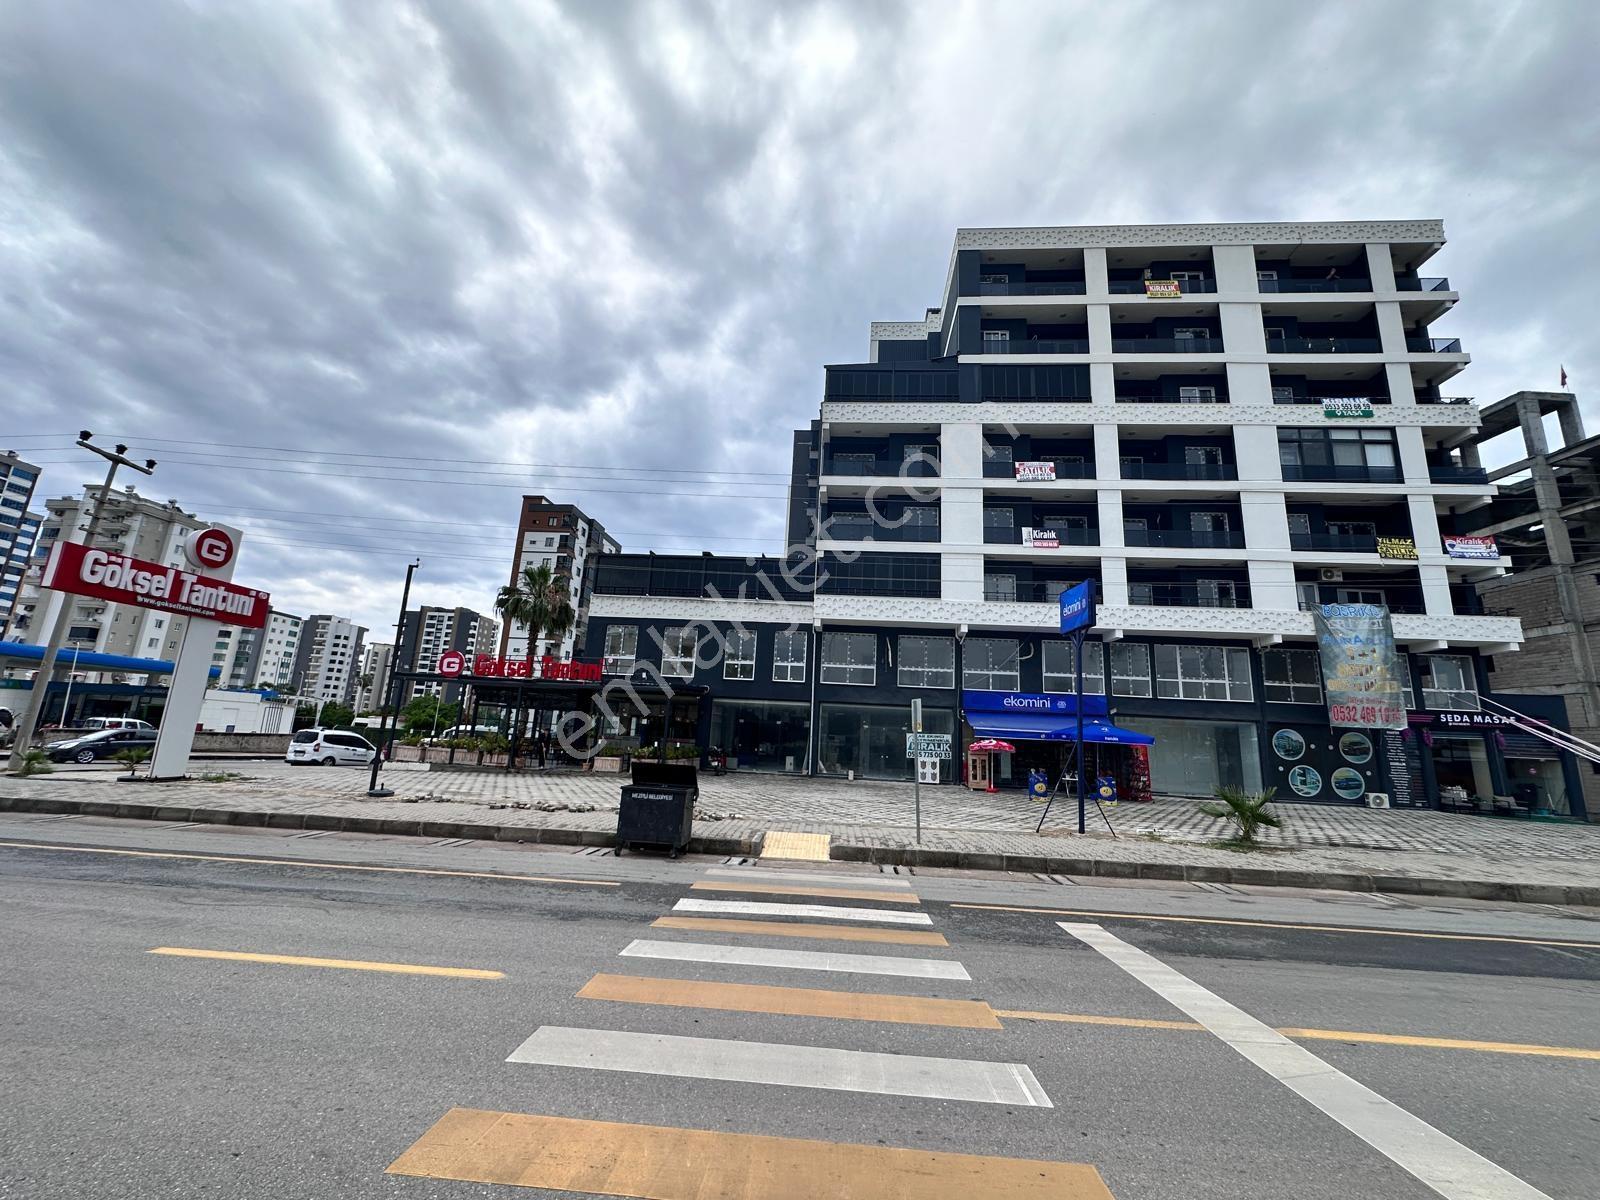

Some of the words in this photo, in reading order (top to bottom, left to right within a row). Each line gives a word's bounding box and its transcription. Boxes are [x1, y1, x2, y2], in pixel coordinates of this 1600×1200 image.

[80, 550, 175, 599] Göksel
[178, 572, 256, 616] Tantuni
[443, 657, 460, 673] G
[1003, 696, 1050, 709] ekomini
[1440, 714, 1471, 723] SEDA
